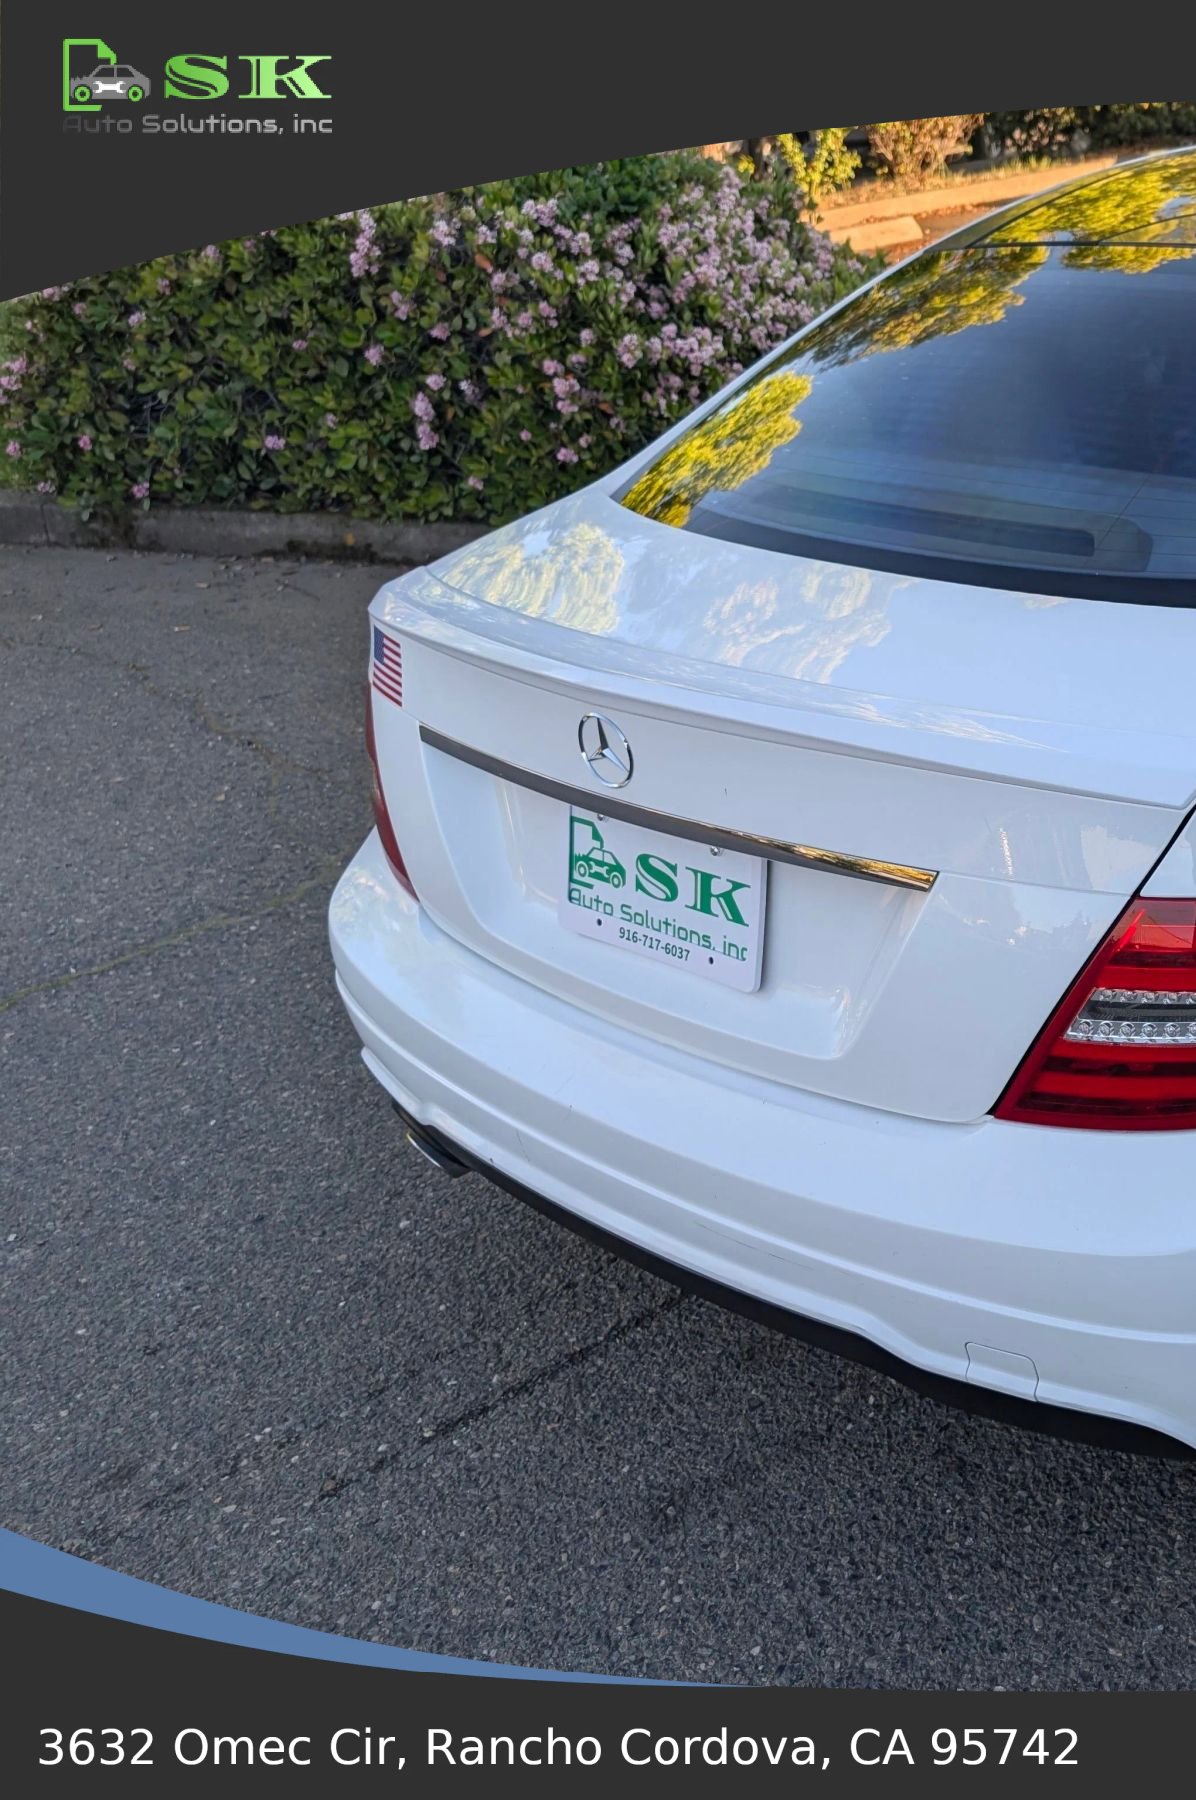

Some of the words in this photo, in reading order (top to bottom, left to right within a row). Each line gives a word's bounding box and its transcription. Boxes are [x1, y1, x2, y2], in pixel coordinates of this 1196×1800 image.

[568, 887, 614, 917] Auto
[619, 903, 716, 951] Solutions,
[722, 934, 748, 962] inc
[635, 853, 752, 928] SK
[618, 926, 691, 962] 916-717-6037
